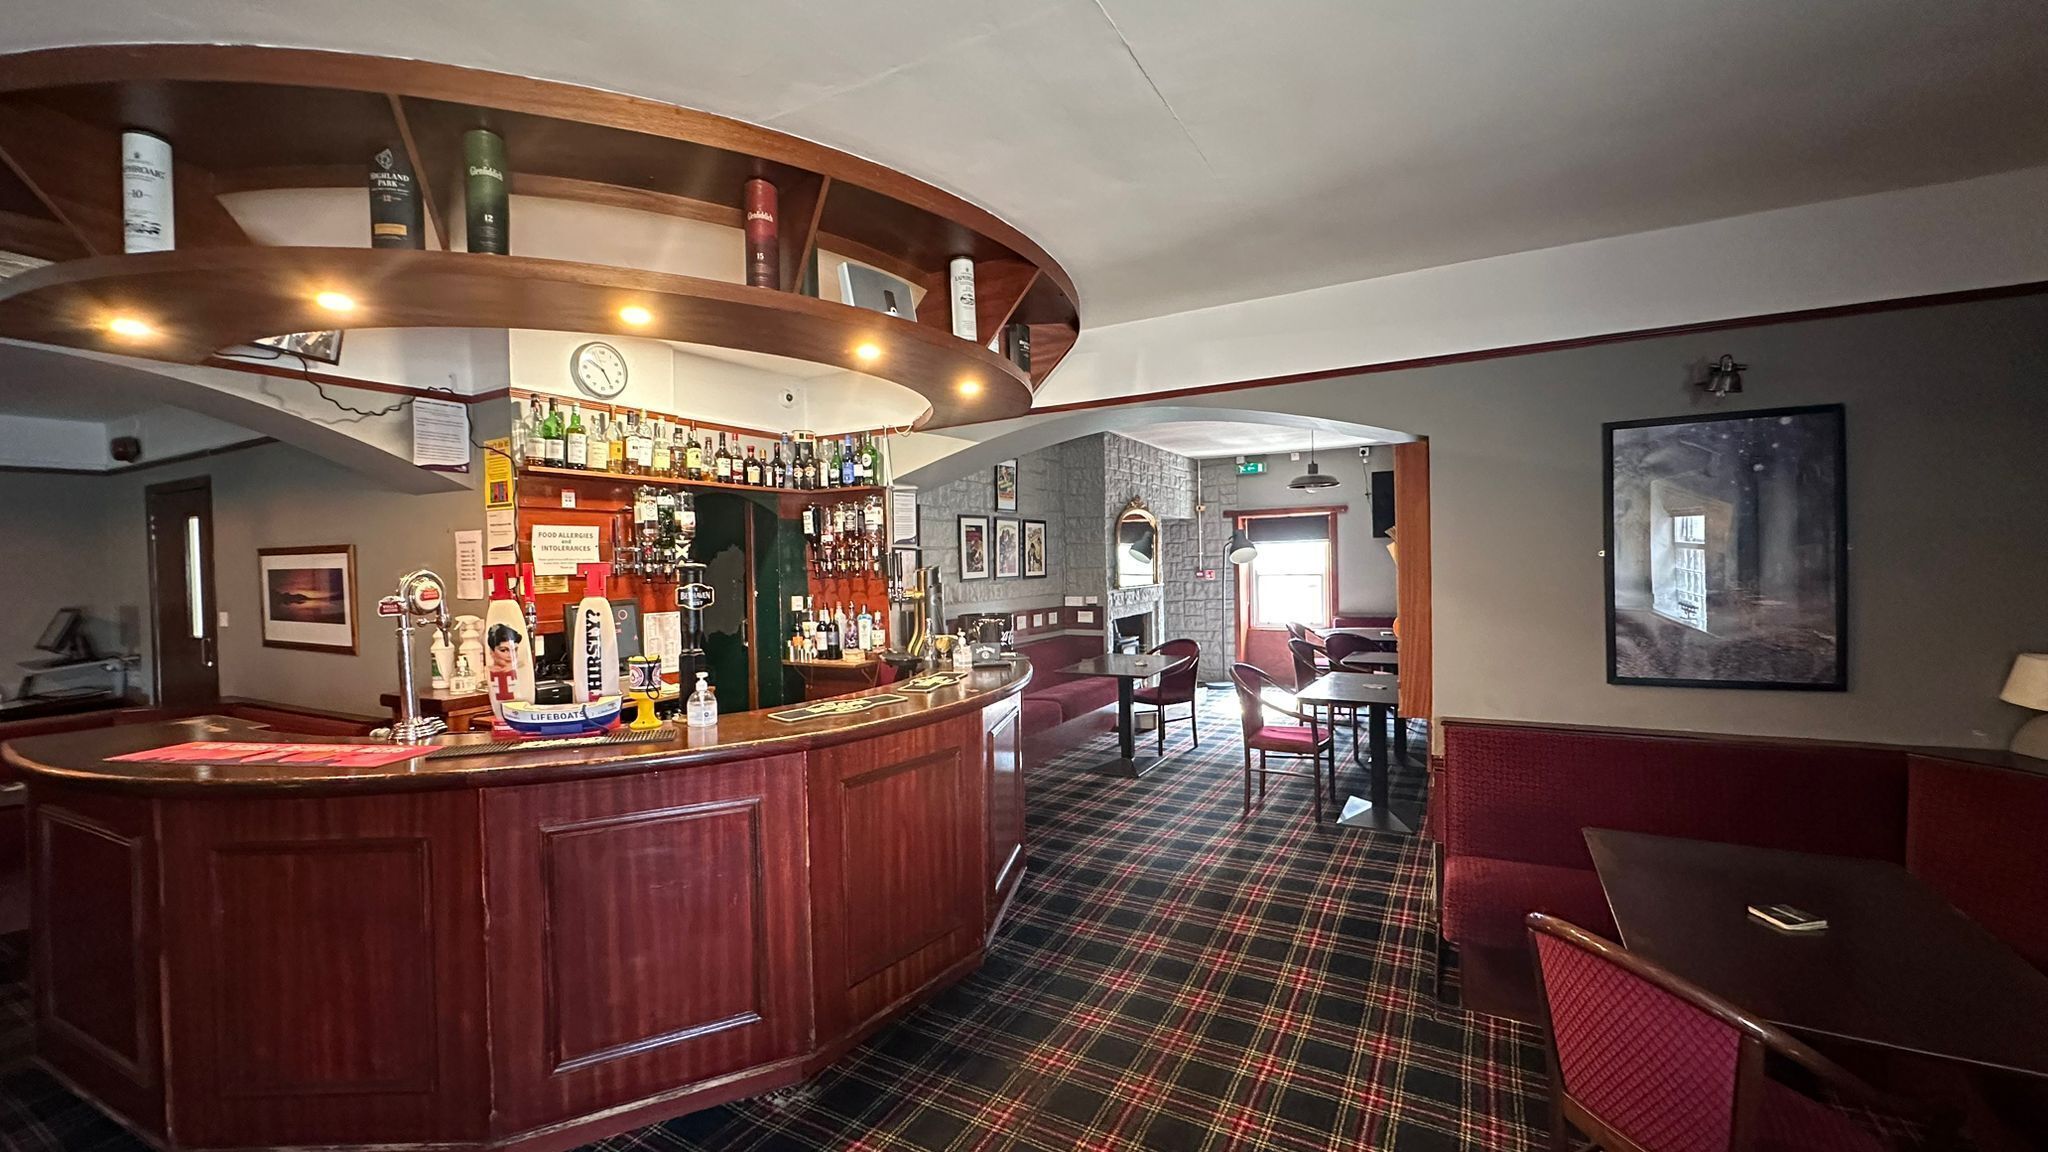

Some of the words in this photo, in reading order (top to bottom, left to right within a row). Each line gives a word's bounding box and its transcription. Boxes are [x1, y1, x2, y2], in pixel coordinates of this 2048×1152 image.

[483, 213, 494, 223] 12
[756, 252, 765, 261] 15
[538, 531, 558, 539] FOOD
[530, 709, 586, 722] LIFEBOATS
